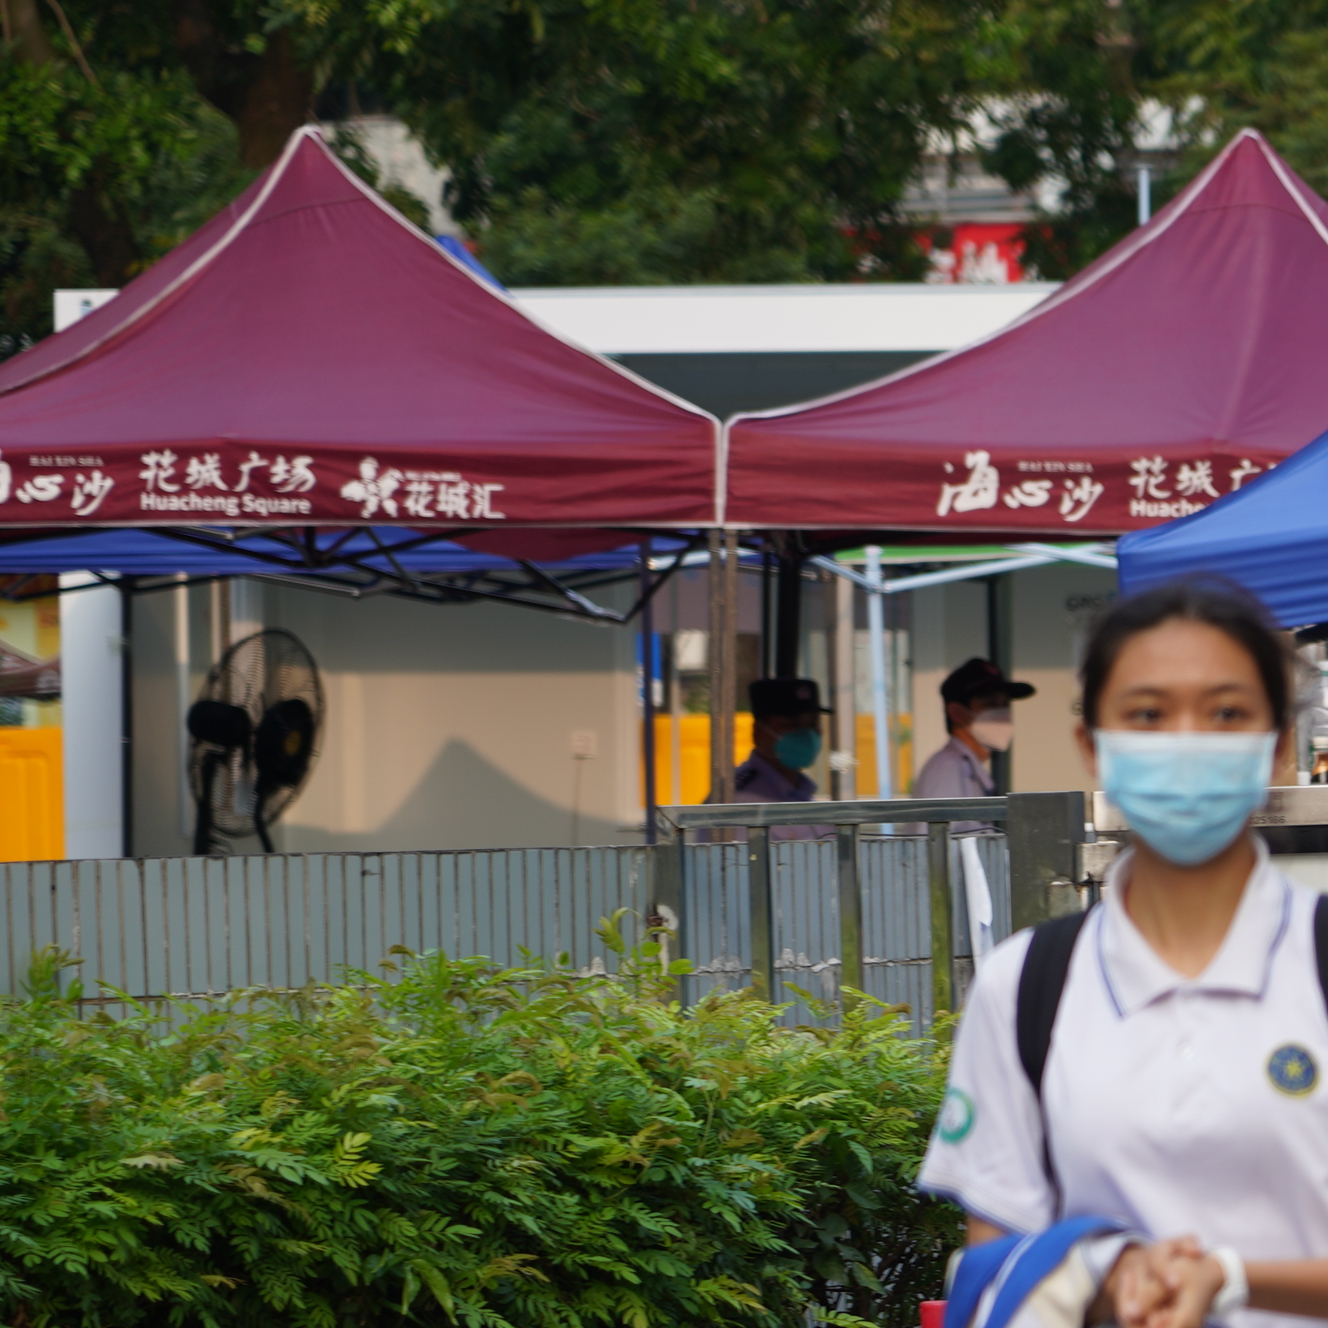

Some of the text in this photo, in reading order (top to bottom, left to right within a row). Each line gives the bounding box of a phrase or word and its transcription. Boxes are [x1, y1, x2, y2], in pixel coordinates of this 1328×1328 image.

[138, 448, 317, 493] 花城广场
[936, 450, 1104, 523] 海心沙
[1128, 454, 1277, 499] 花城广
[139, 492, 312, 517] Huacheng Square
[403, 481, 507, 520] 花城汇
